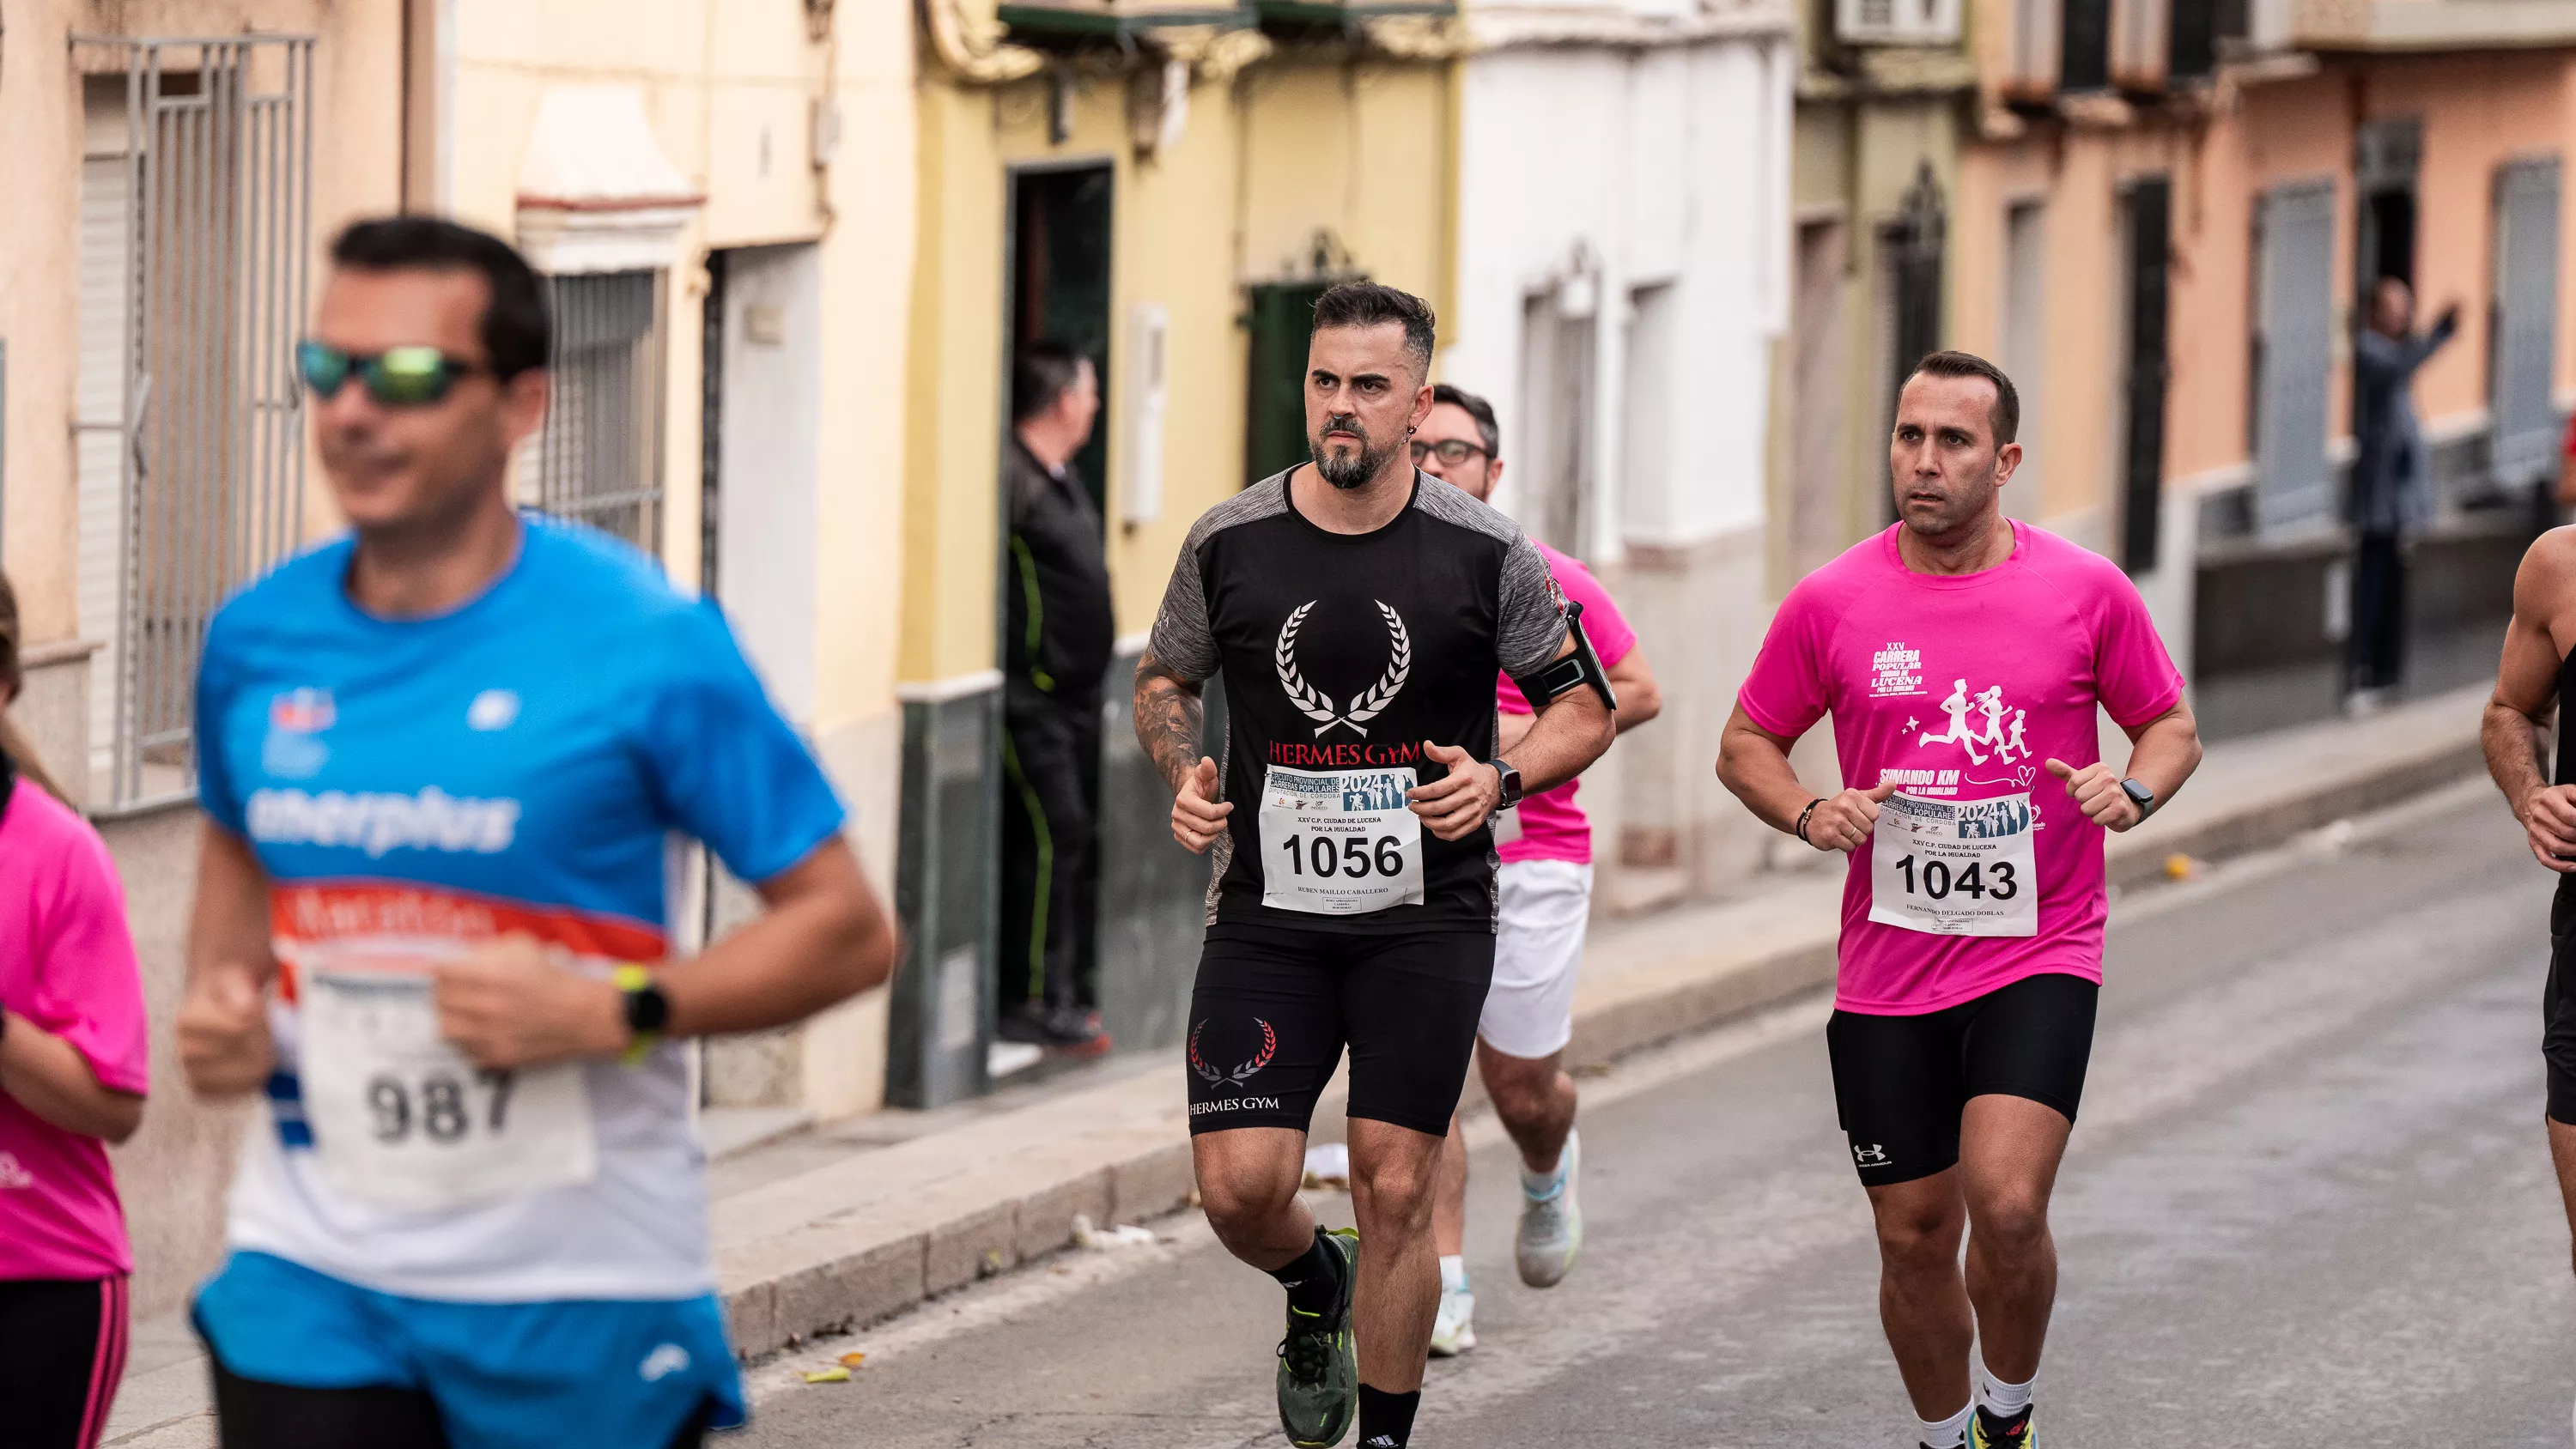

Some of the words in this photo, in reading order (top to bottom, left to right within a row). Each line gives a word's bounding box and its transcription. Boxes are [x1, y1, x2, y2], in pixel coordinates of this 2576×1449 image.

[1886, 641, 1905, 651] XXV
[1873, 650, 1920, 664] CARRERA
[1872, 662, 1922, 671] POPULAR
[1870, 676, 1923, 688] LUCENA
[1270, 740, 1359, 765] HERMES
[1364, 741, 1419, 764] GYM
[1271, 772, 1293, 782] CIRCUITO
[1293, 776, 1329, 785] PROVINCIAL
[1342, 774, 1382, 792] 2024
[1880, 768, 1935, 785] SUMANDO
[1936, 770, 1960, 785] KM
[1270, 779, 1298, 791] CARRERAS
[1298, 784, 1340, 792] POPULARES
[1905, 786, 1917, 795] POR
[1918, 786, 1926, 795] LA
[1889, 796, 1905, 805] CUITO
[1906, 800, 1945, 811] PROVINCIAL
[1914, 809, 1956, 820] POPULARES
[1958, 803, 1999, 822] 2024
[1283, 834, 1403, 878] 1056
[1896, 853, 2018, 900] 1043
[1906, 904, 1941, 915] FERNANDO
[368, 1070, 518, 1147] 987
[1189, 1097, 1239, 1115] HERMES
[1242, 1097, 1279, 1109] GYM
